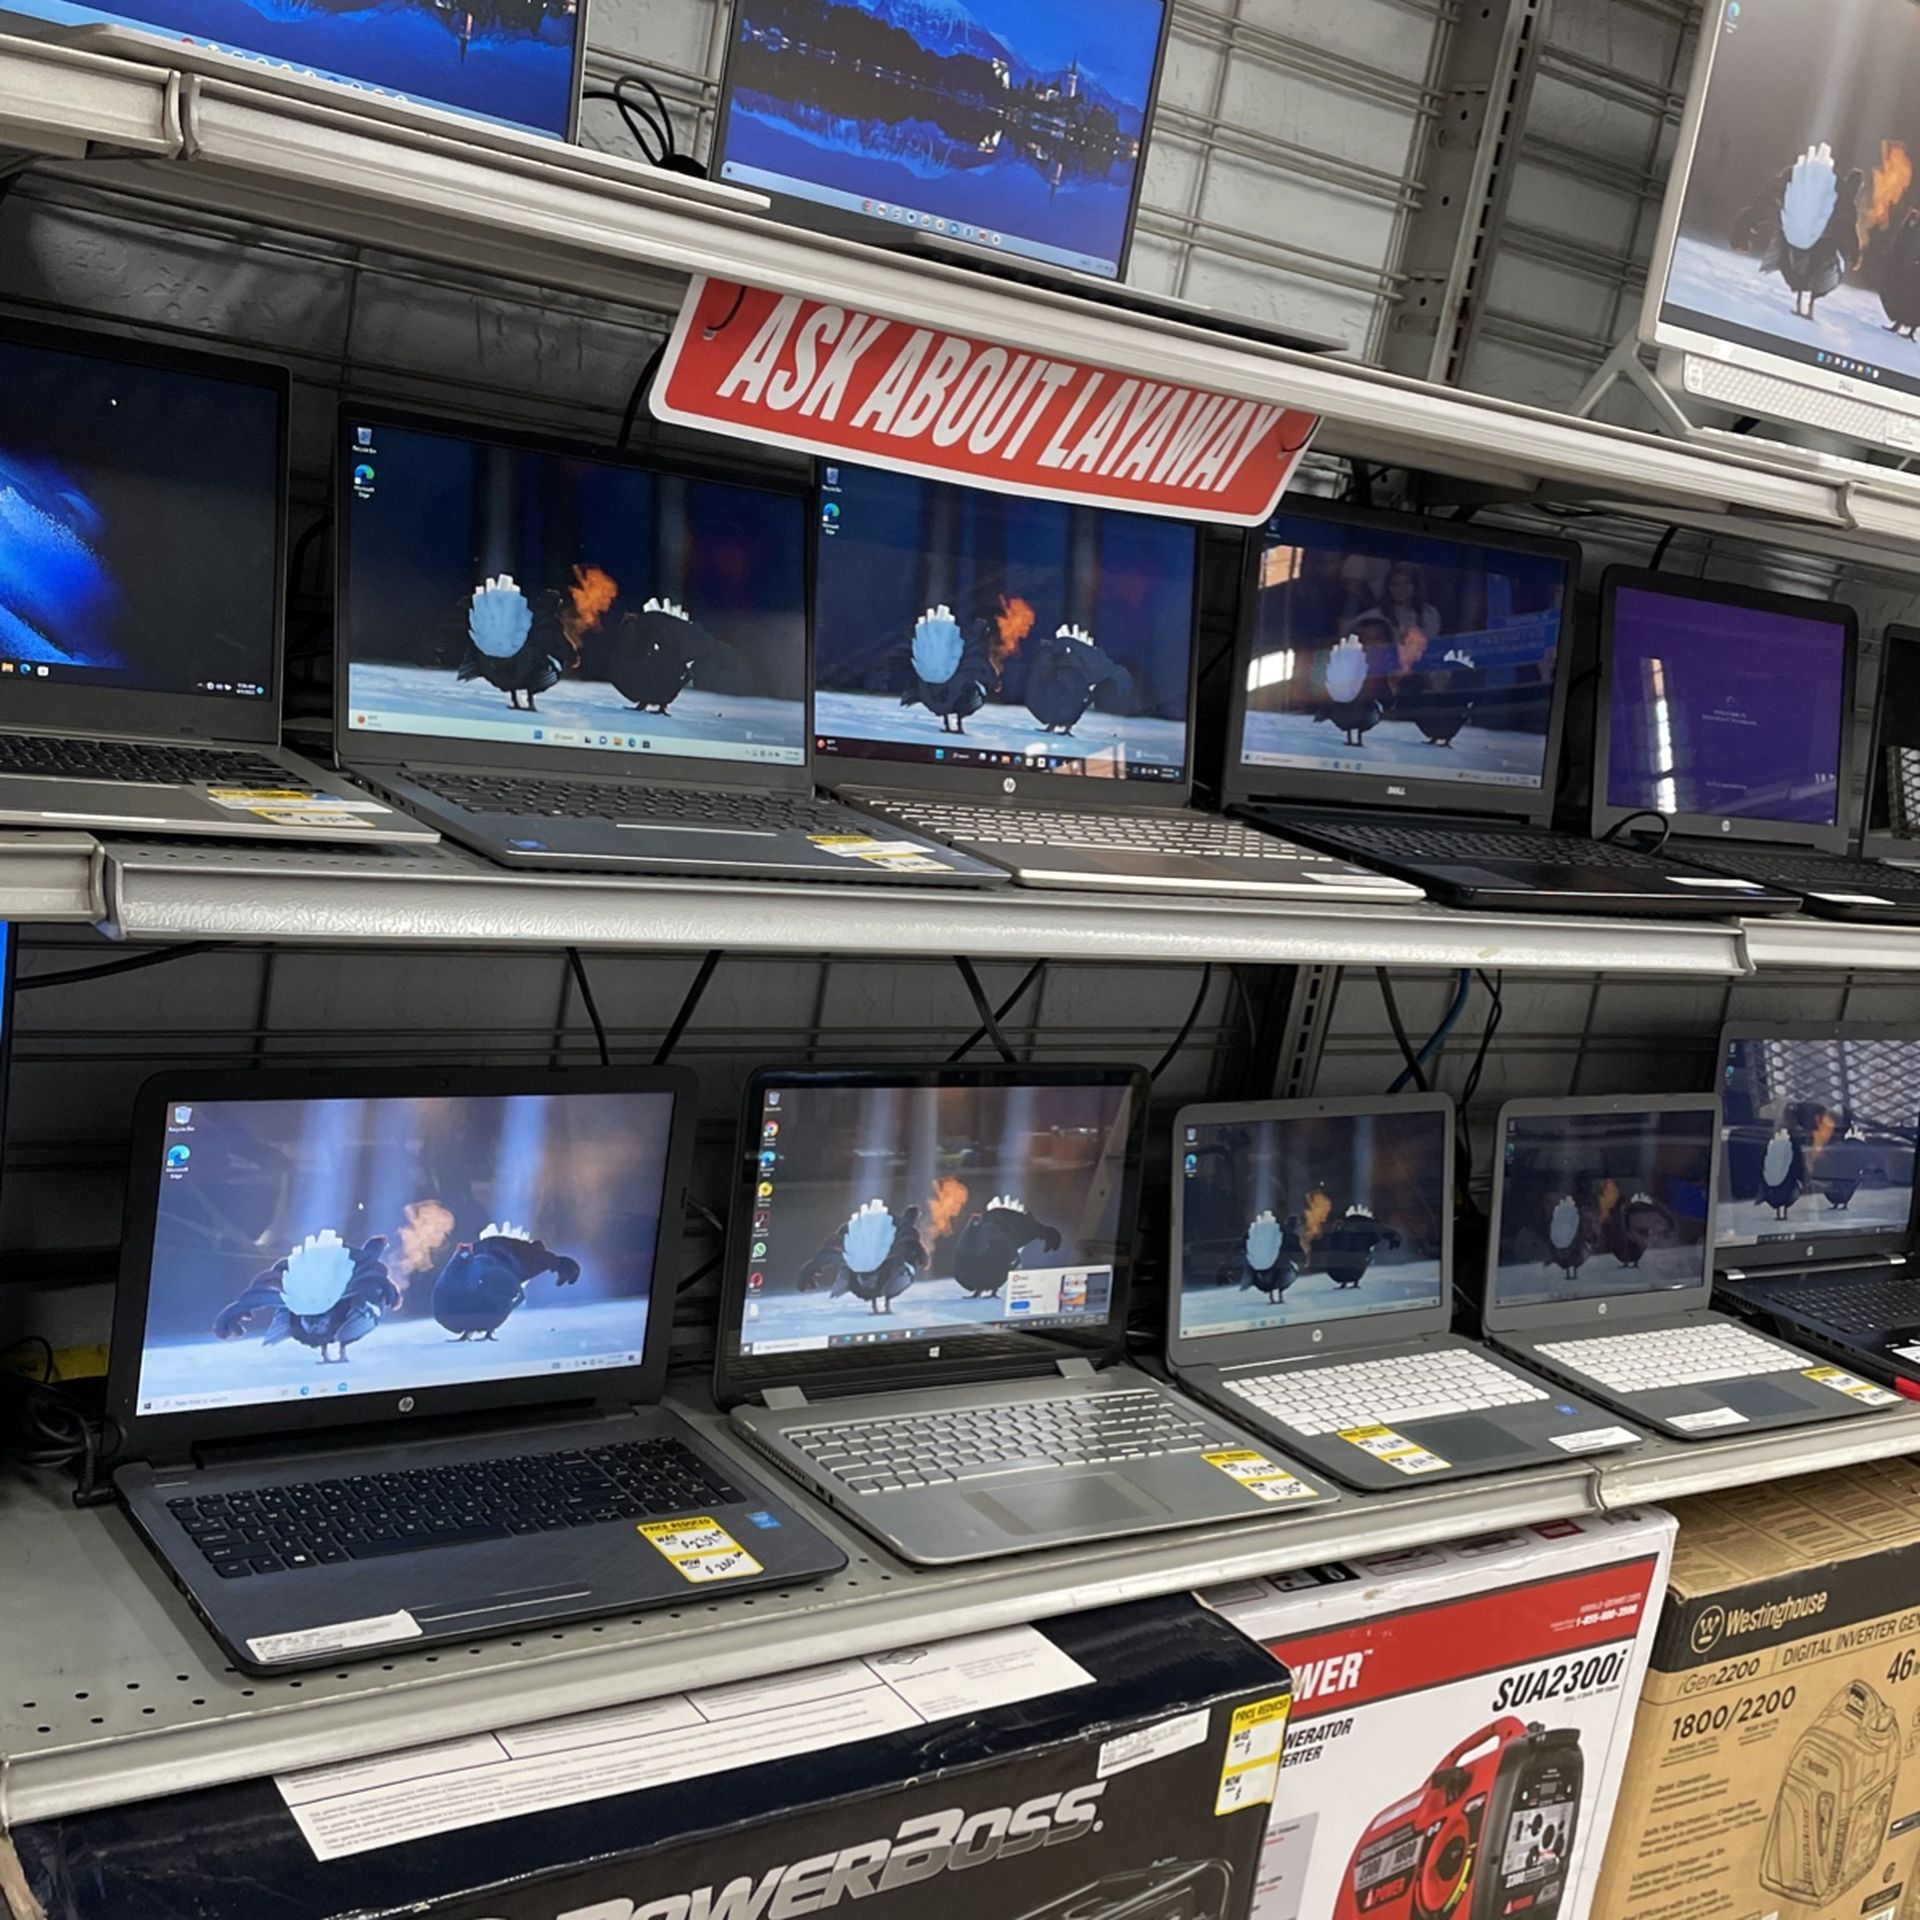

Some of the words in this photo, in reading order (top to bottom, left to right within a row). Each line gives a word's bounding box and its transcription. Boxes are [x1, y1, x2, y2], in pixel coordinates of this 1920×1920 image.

[716, 295, 891, 421] ASK
[849, 329, 1077, 461] ABOUT
[1037, 371, 1287, 493] LAYAWAY
[1726, 1591, 1828, 1637] Westinghouse
[1782, 1643, 1833, 1667] DIGITAL
[1836, 1619, 1896, 1649] INVERTER
[1886, 1647, 1916, 1685] 46
[1491, 1649, 1628, 1712] SUA2300i
[1677, 1657, 1761, 1695] iGen2200
[1235, 1709, 1256, 1722] PRICE
[1671, 1685, 1796, 1742] 1800/2200
